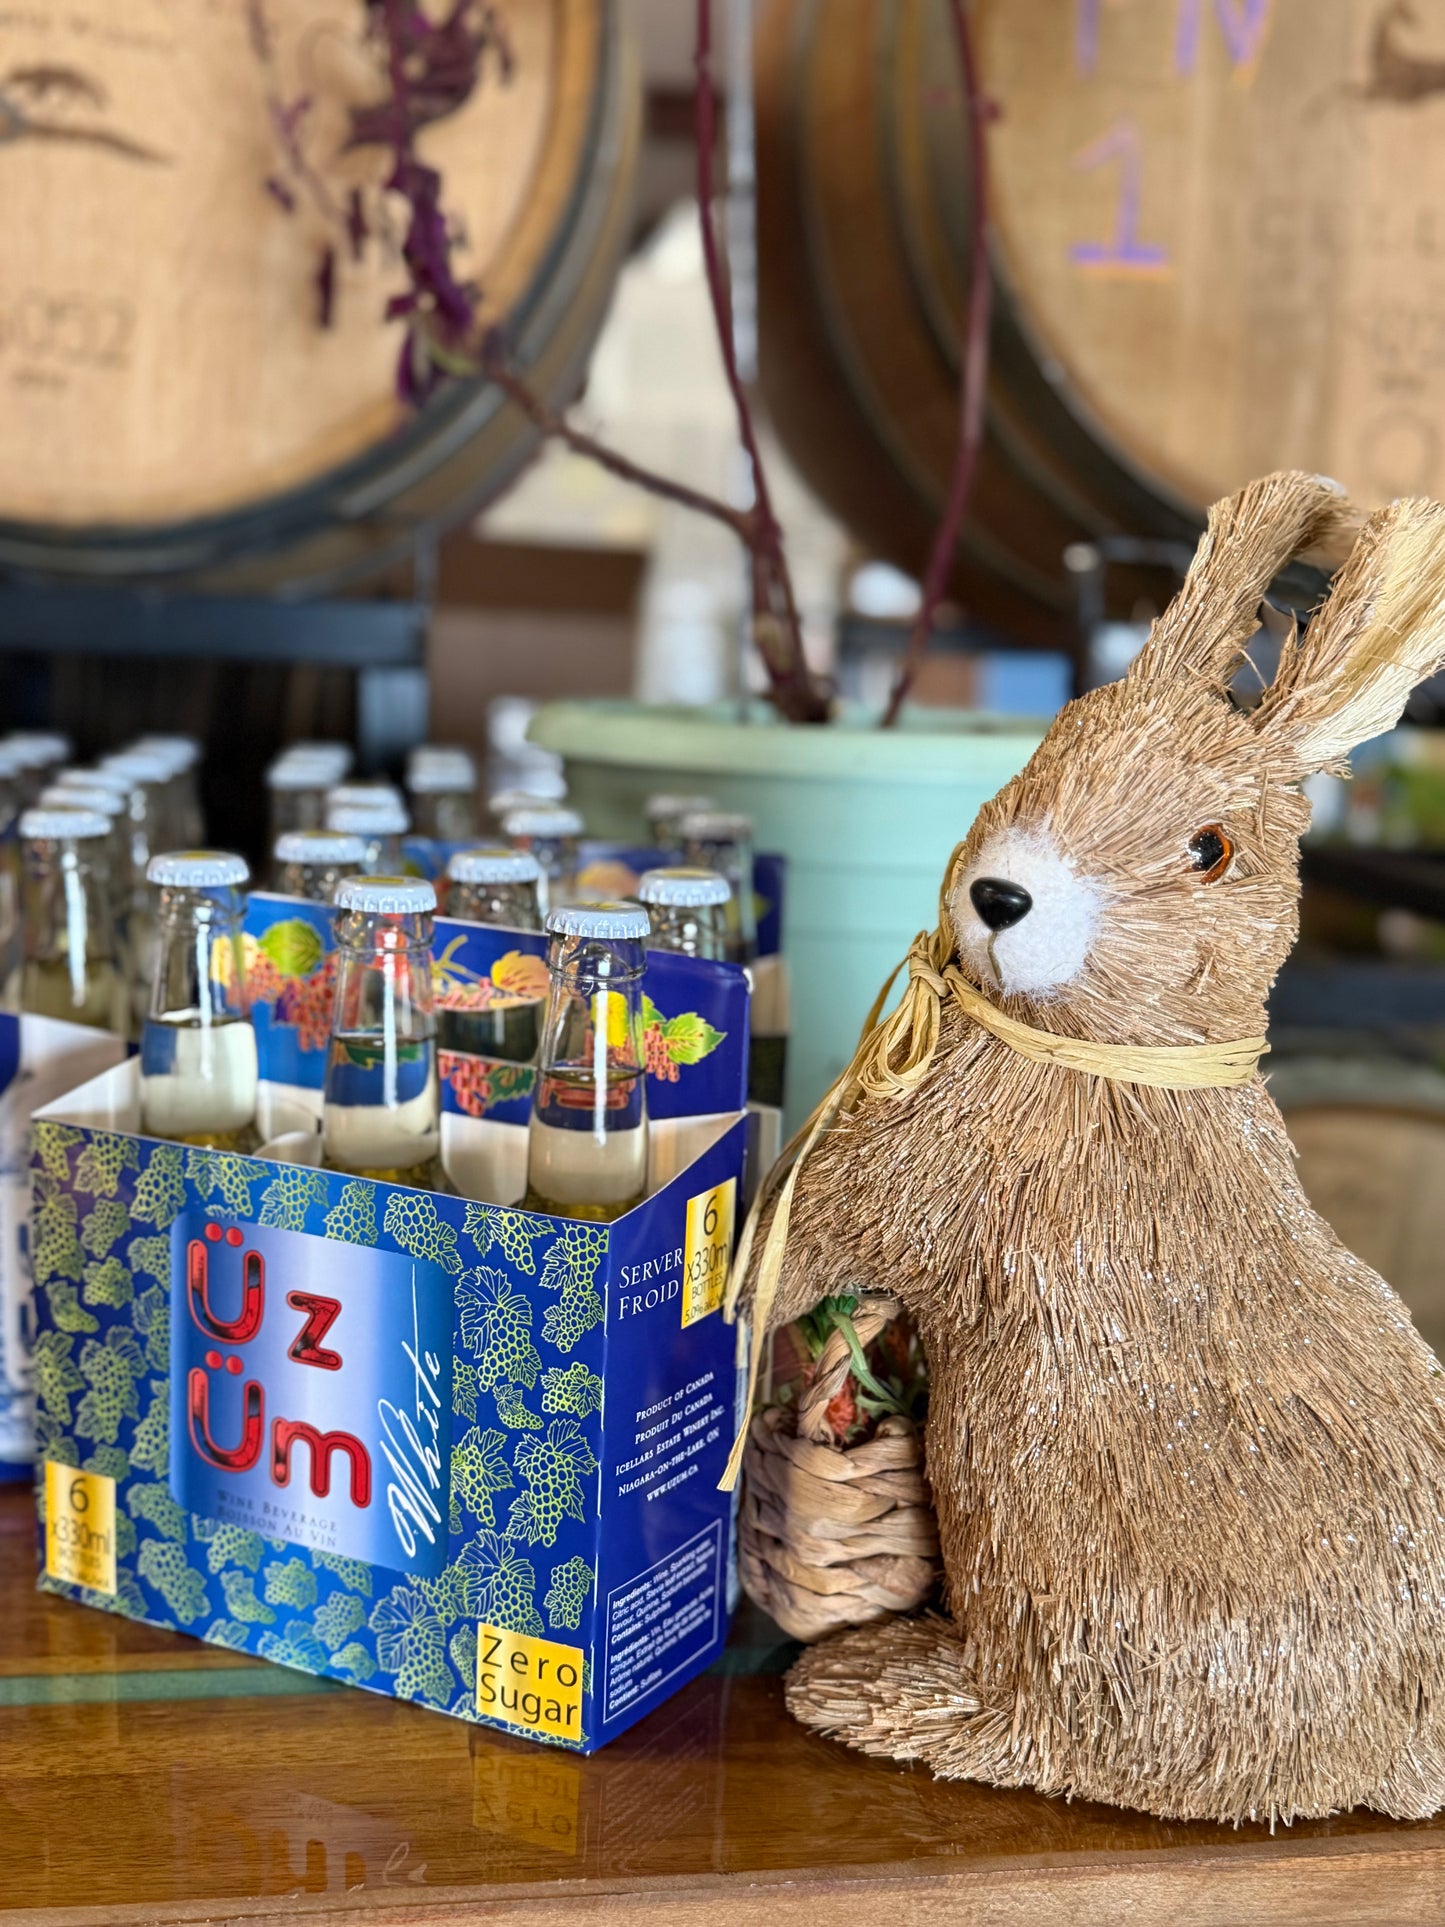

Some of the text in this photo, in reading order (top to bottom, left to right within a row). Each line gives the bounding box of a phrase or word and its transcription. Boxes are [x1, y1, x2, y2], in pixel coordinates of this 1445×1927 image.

[1068, 118, 1170, 270] 1
[703, 1194, 718, 1236] 6
[619, 1248, 683, 1288] SERVER
[618, 1279, 679, 1321] FROID
[379, 1263, 441, 1557] White
[634, 1419, 669, 1445] PRODUIT
[685, 1393, 713, 1415] CANADA
[635, 1396, 672, 1423] PRODUCT
[686, 1372, 714, 1394] CANADA
[615, 1450, 654, 1476] ICELLARS
[656, 1432, 682, 1455] ESTATE
[70, 1478, 89, 1513] 6
[263, 1501, 338, 1532] BEVERAGE
[482, 1634, 577, 1687] Zero
[480, 1673, 578, 1725] Sugar
